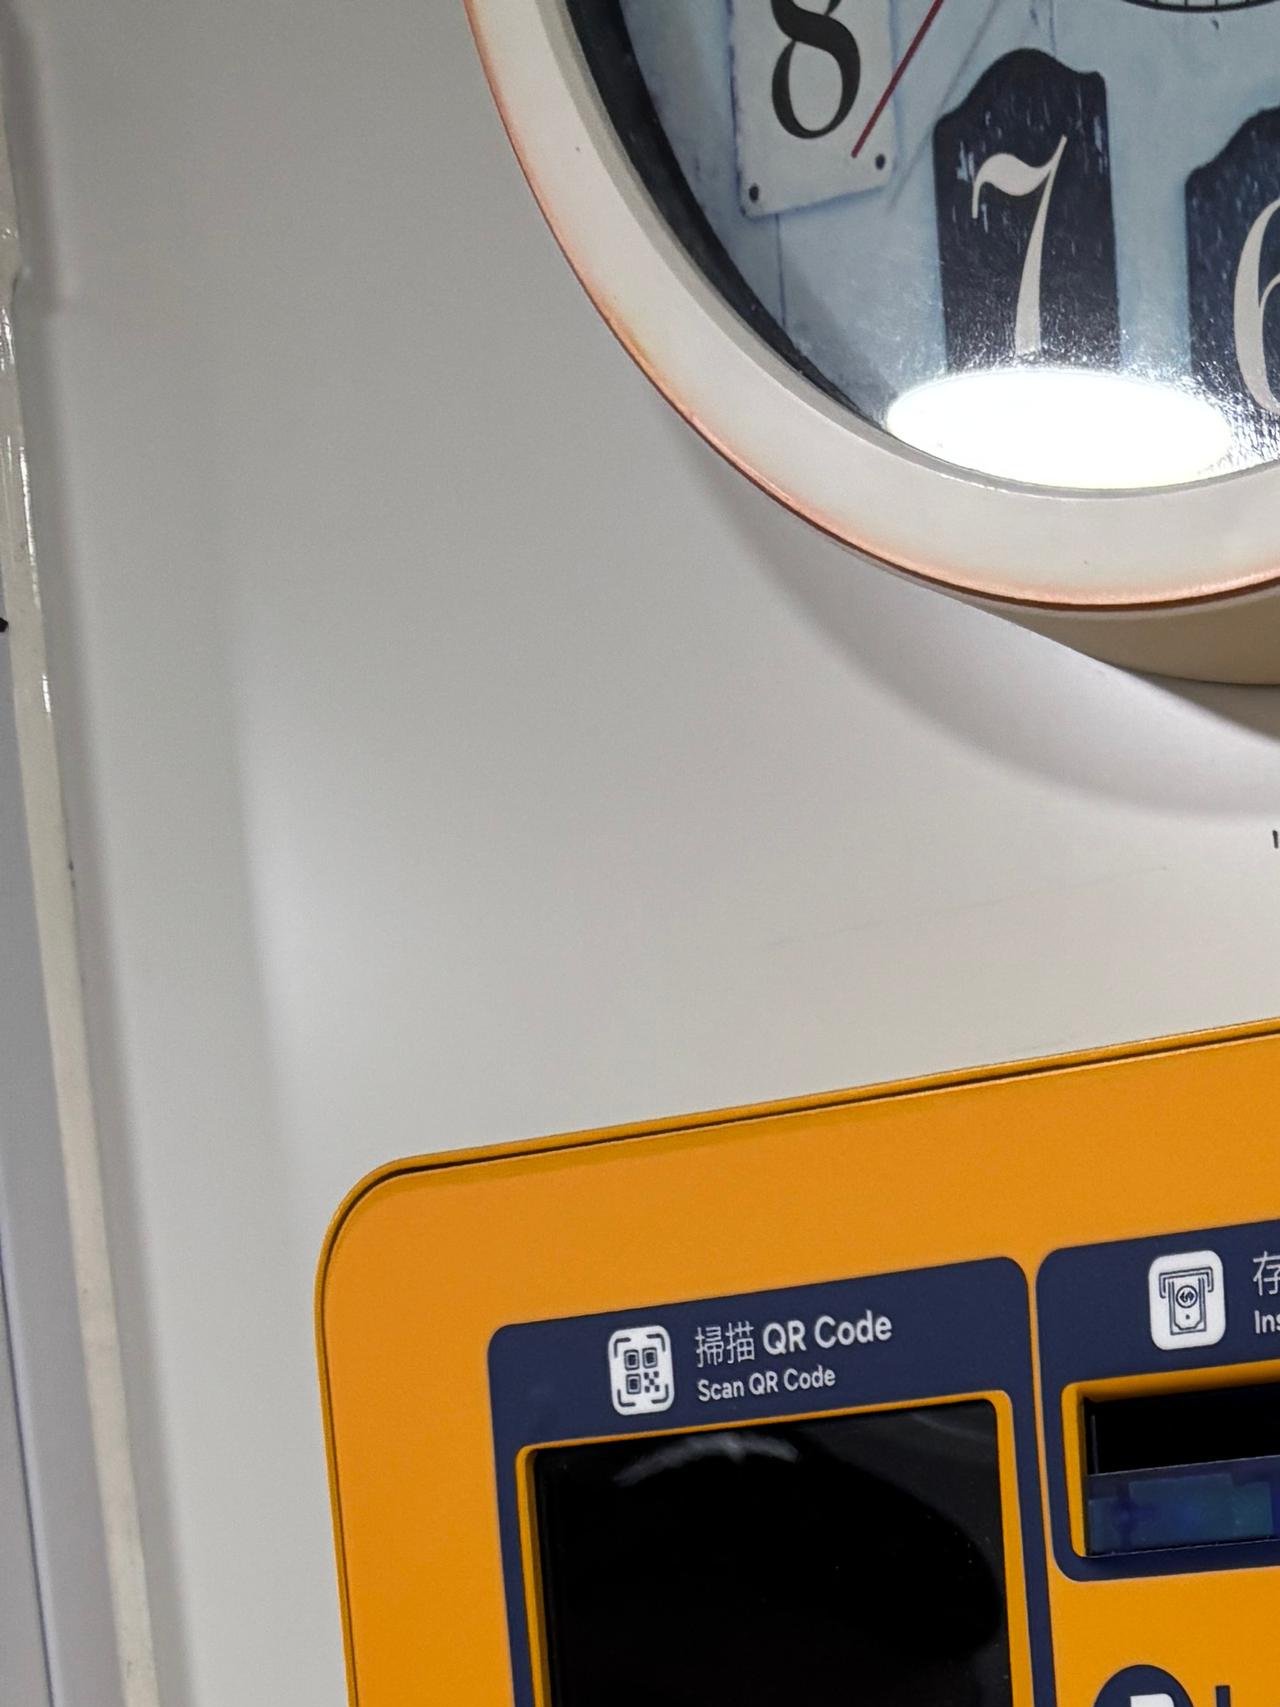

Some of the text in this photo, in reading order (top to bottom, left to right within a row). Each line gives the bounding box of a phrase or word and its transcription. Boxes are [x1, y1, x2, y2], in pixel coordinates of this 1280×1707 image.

[773, 0, 864, 139] 8
[969, 135, 1069, 356] 7
[695, 1309, 893, 1368] 掃描 QR Code
[697, 1364, 836, 1402] Scan QR Code
